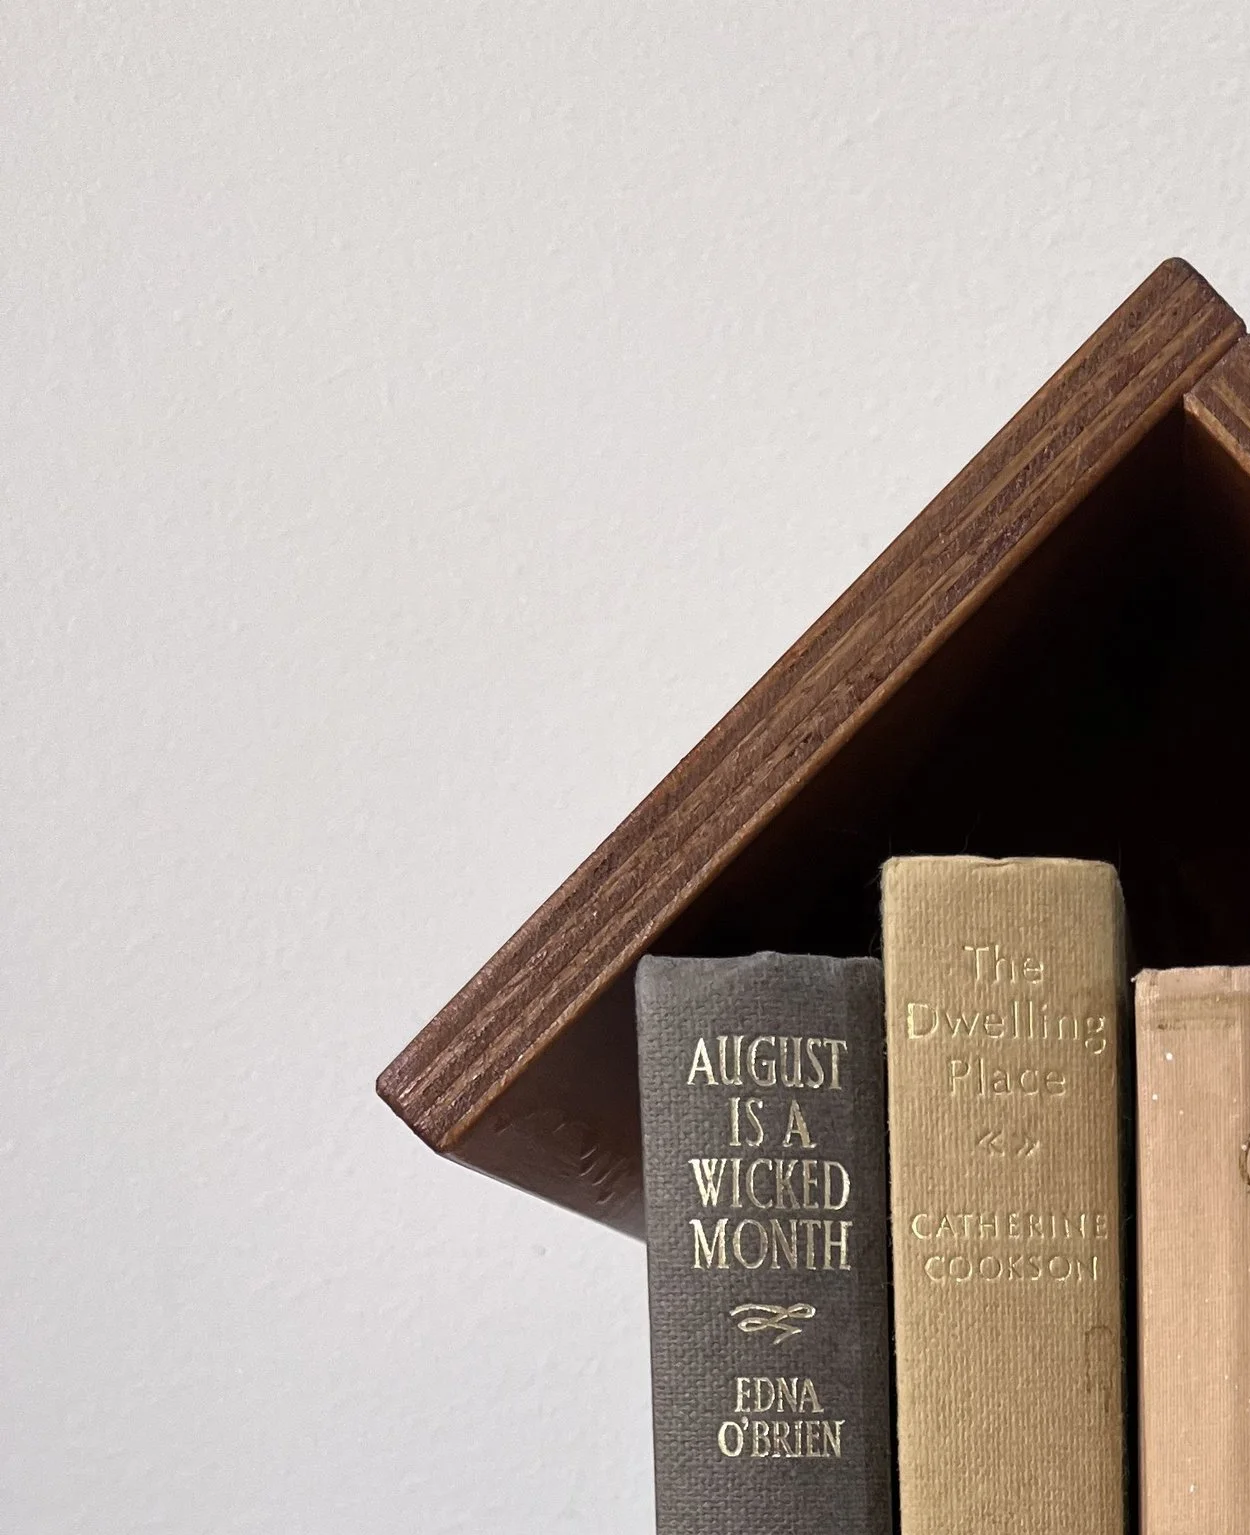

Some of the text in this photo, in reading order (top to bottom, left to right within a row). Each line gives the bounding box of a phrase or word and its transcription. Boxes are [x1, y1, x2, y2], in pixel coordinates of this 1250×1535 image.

[964, 945, 1044, 984] The
[907, 1002, 1107, 1055] Dwelling
[687, 1036, 847, 1090] AUGUST
[949, 1058, 1067, 1096] Place
[729, 1097, 816, 1148] IS A
[688, 1158, 850, 1210] WICKED
[690, 1218, 852, 1270] MONTH
[911, 1212, 1109, 1240] CATHERINE
[924, 1255, 1098, 1281] COOKSON
[734, 1376, 824, 1414] EDNA
[717, 1417, 845, 1459] O'BRIEN
